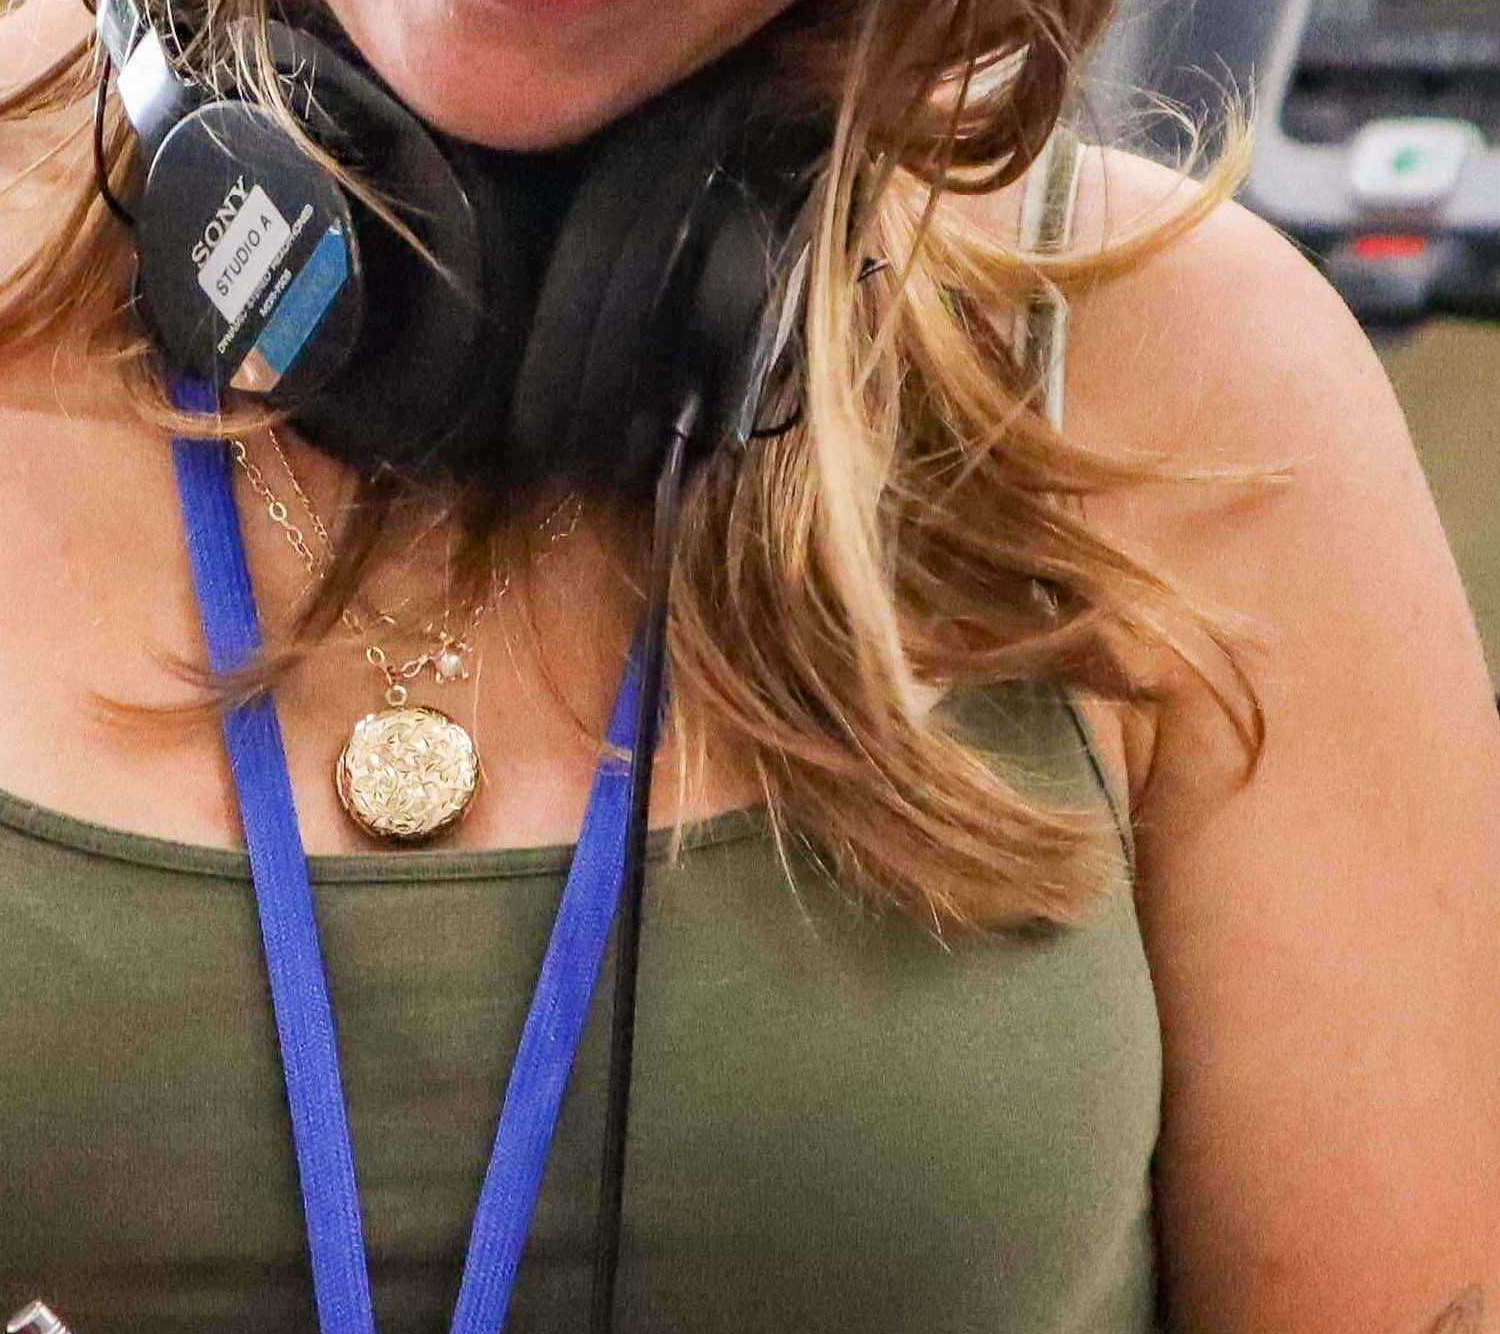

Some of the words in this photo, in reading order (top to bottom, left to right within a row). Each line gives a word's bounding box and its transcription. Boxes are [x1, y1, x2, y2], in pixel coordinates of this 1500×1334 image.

[190, 175, 250, 266] SONY
[216, 229, 262, 297] STUDIO
[260, 214, 273, 230] A
